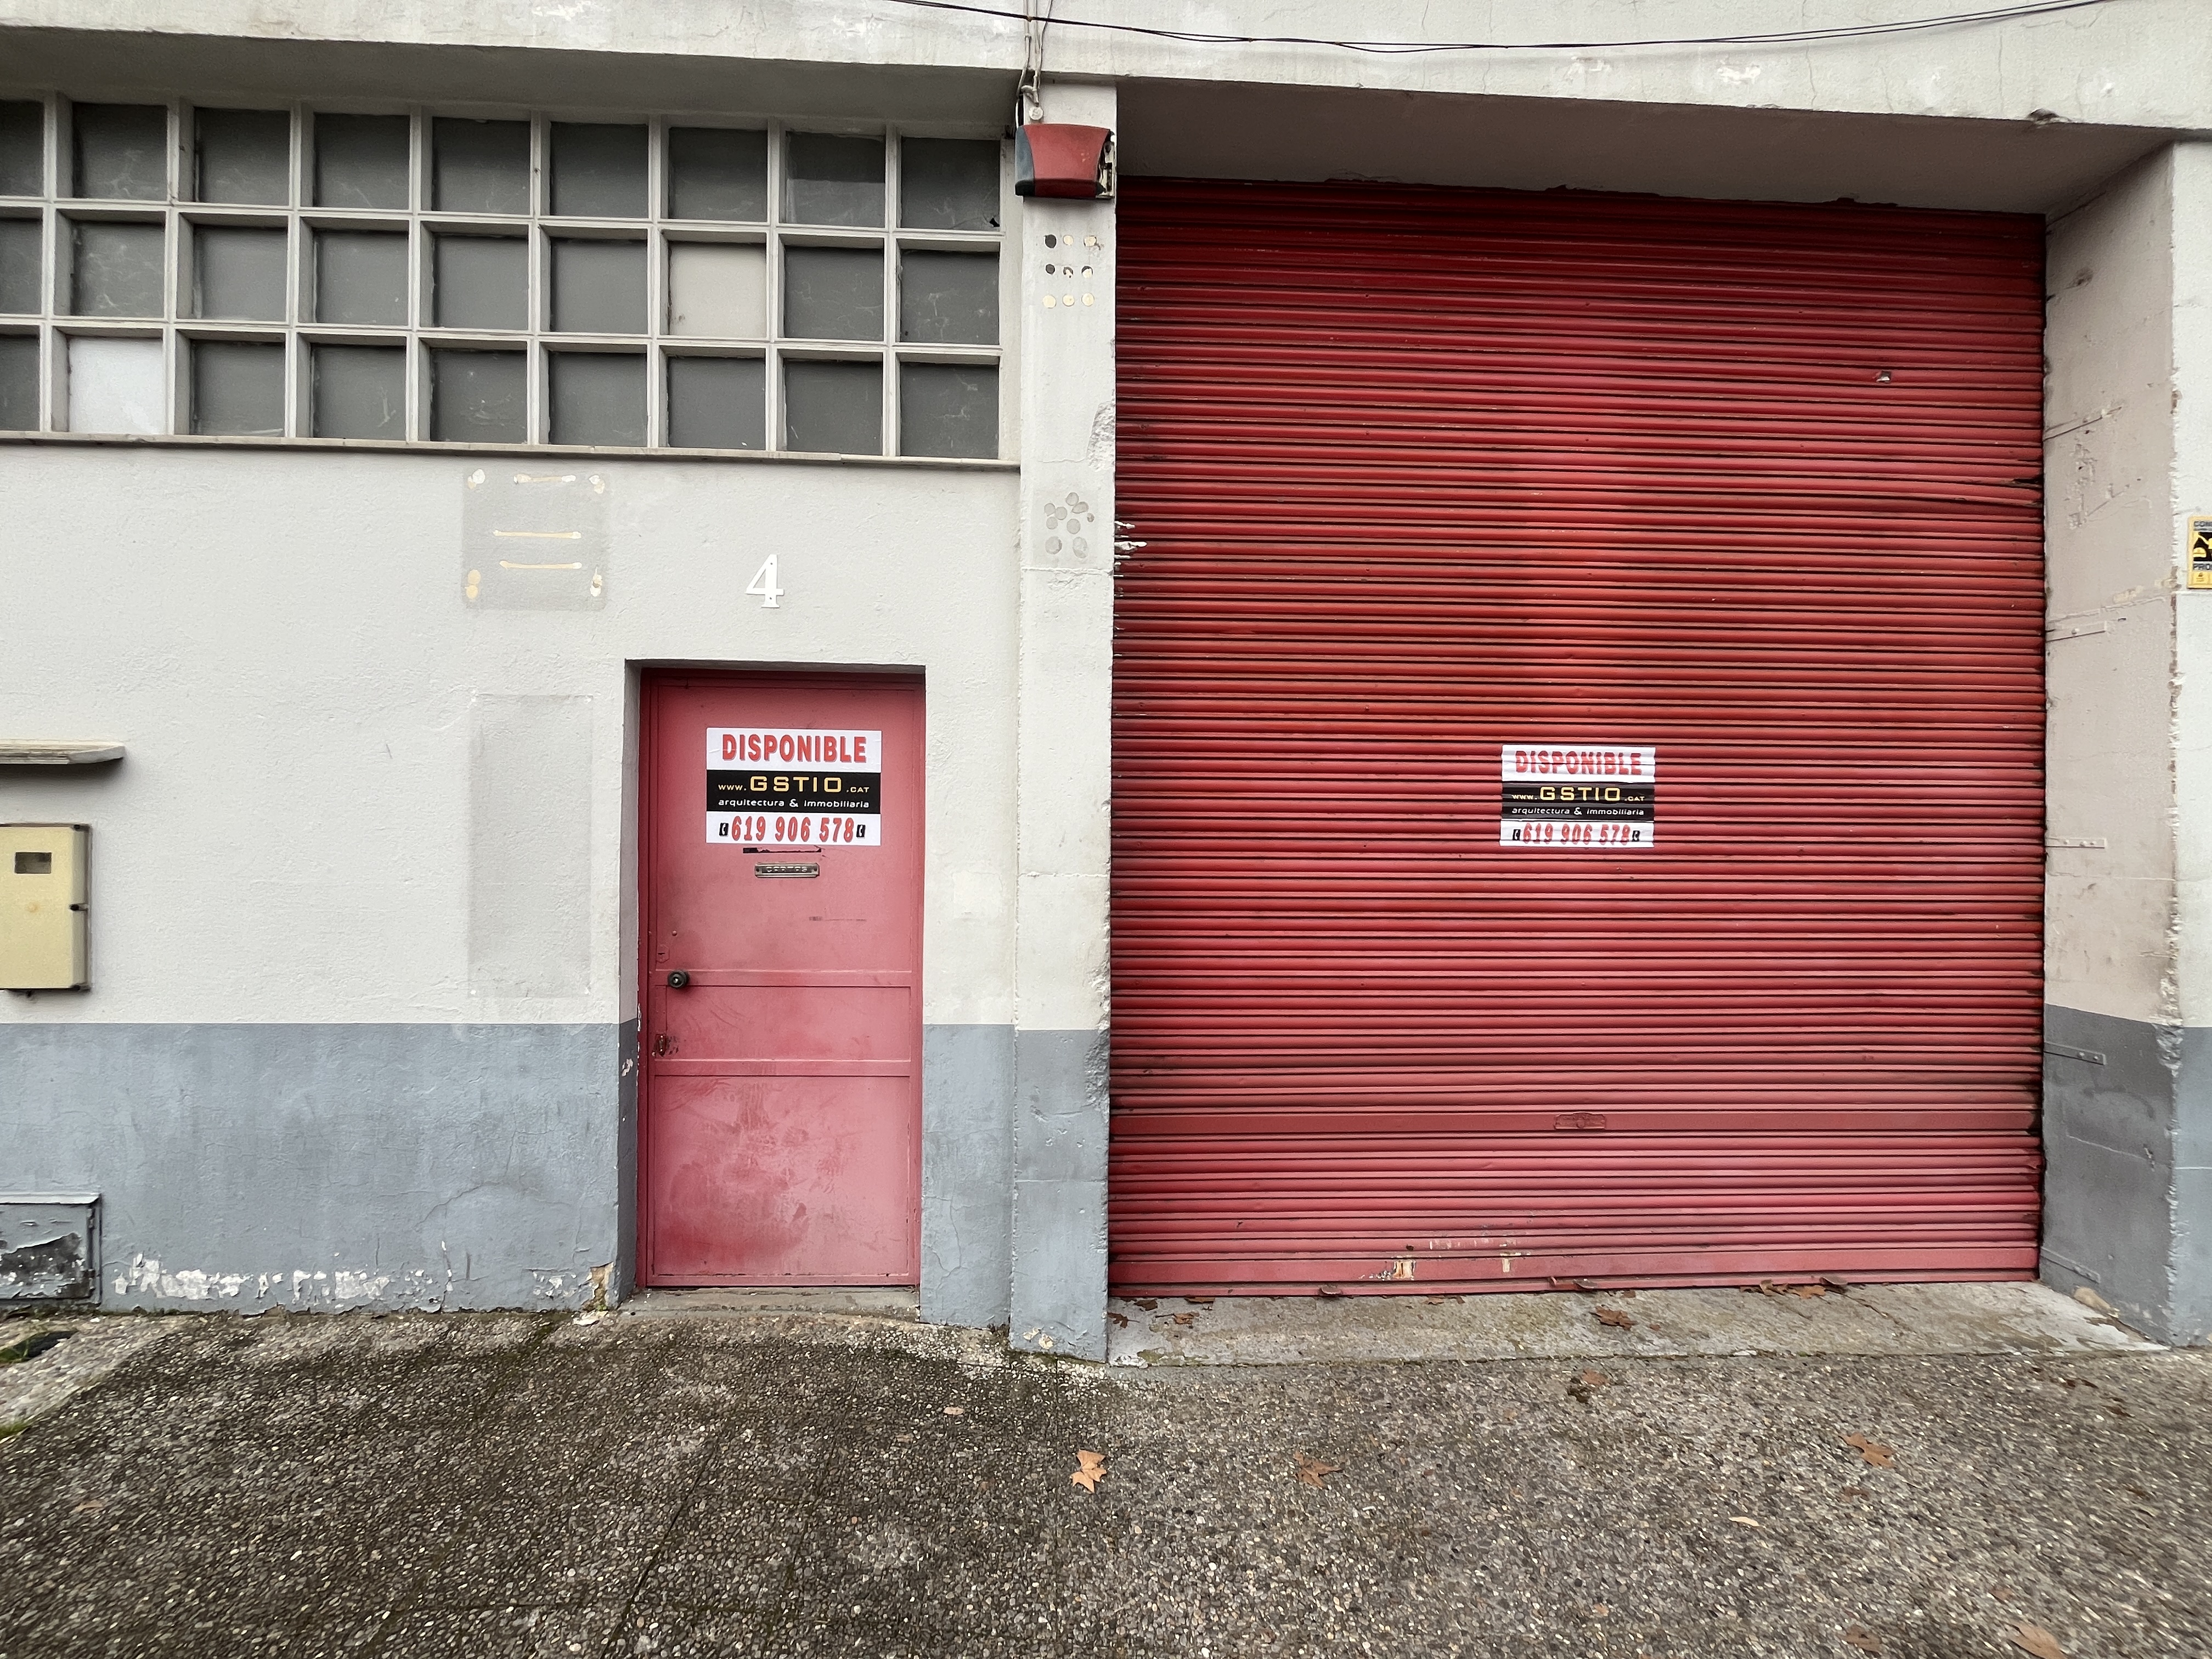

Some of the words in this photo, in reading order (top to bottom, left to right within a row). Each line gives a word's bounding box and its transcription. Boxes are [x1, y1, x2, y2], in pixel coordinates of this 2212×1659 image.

[745, 554, 785, 608] 4
[722, 734, 867, 763] DISPONIBLE
[1515, 751, 1642, 775] DISPONIBLE
[718, 776, 870, 793] www.GSTIO.CAT
[789, 799, 799, 808] &
[804, 800, 869, 808] immobiliaria
[1573, 807, 1582, 815] &
[731, 816, 766, 841] 619
[775, 816, 811, 842] 906
[819, 817, 854, 843] 578
[1523, 823, 1553, 844] 619
[1561, 823, 1592, 845] 906
[1599, 824, 1630, 845] 578
